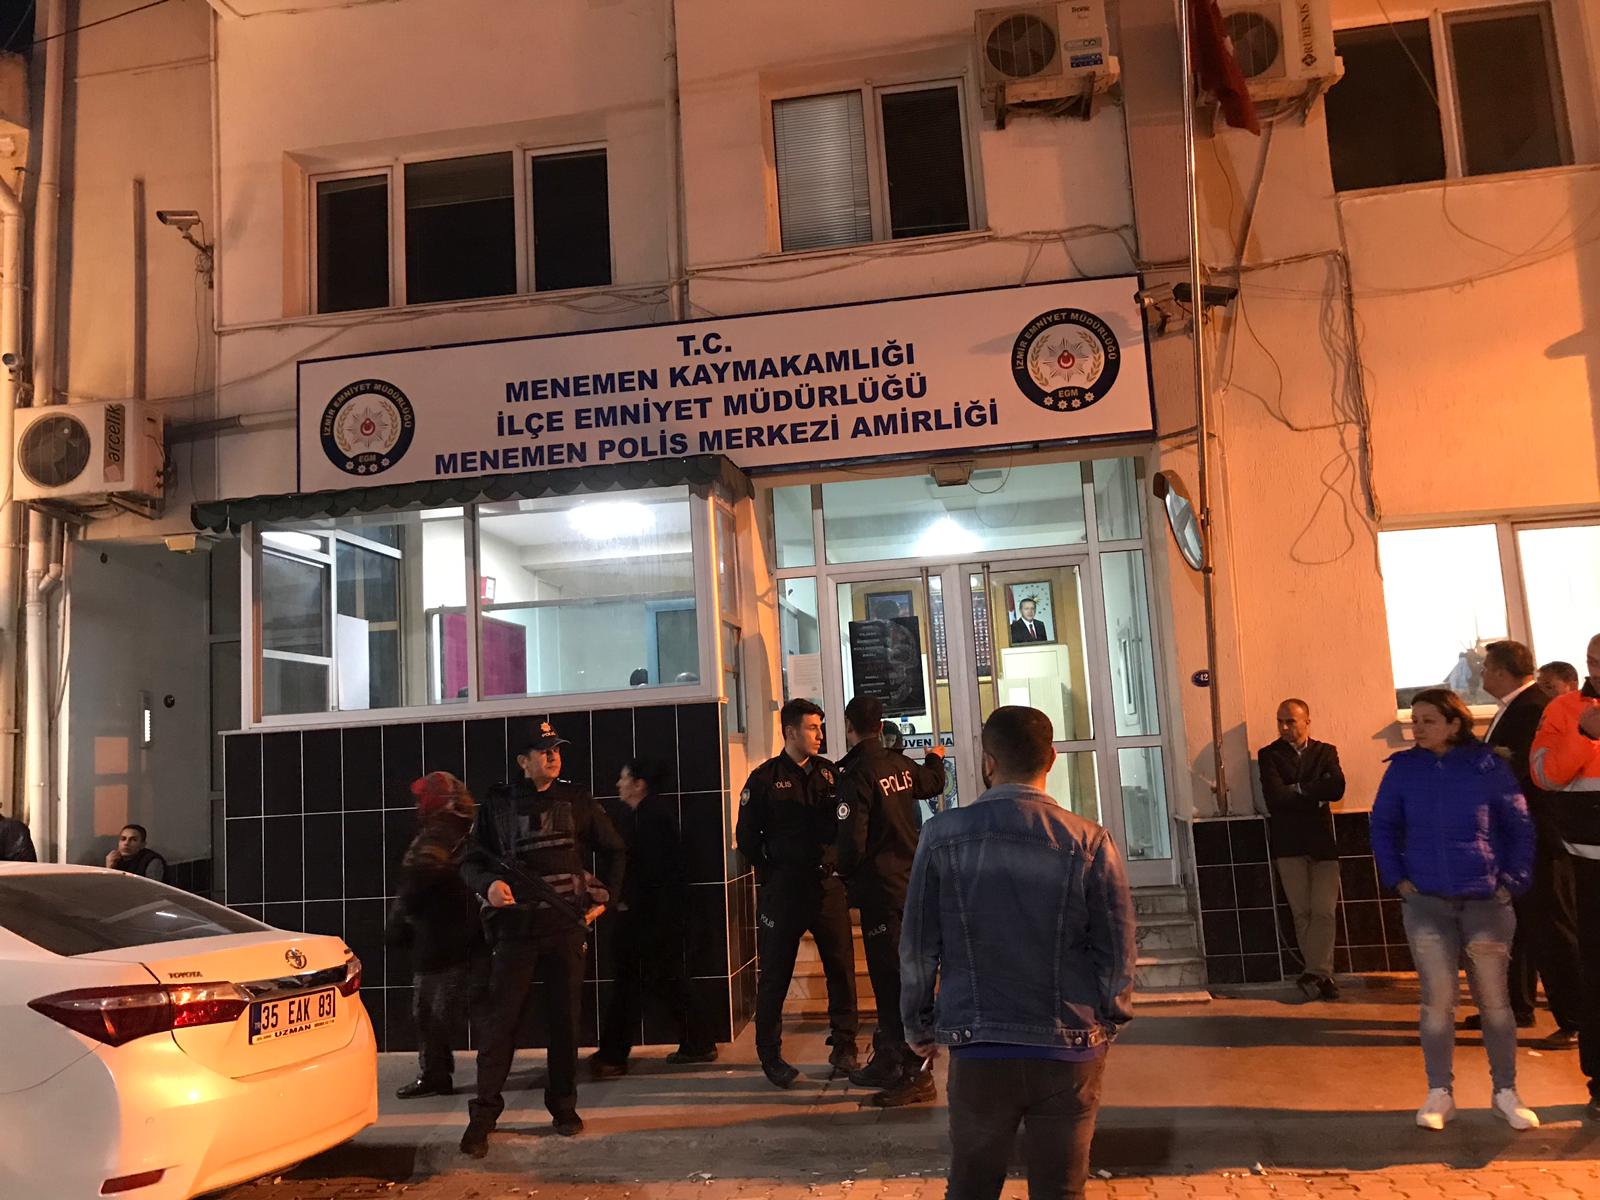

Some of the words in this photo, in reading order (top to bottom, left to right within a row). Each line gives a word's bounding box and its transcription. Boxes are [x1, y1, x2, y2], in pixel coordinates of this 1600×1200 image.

[1024, 312, 1068, 339] EMNİYET
[677, 333, 732, 356] T.C.
[506, 371, 659, 403] MENEMEN
[670, 340, 915, 388] KAYMAKAMLIĞI
[334, 383, 372, 408] EMNİYET
[497, 408, 565, 439] İLÇE
[573, 396, 714, 428] EMNİYET
[724, 373, 926, 416] MÜDÜRLÜĞÜ
[1058, 389, 1079, 398] EGM
[435, 440, 587, 475] MENEMEN
[599, 428, 688, 460] POLİS
[699, 415, 839, 452] MERKEZİ
[851, 399, 998, 438] AMİRLİĞİ
[262, 1004, 279, 1030] 35
[288, 998, 311, 1024] EAK
[318, 993, 332, 1018] 83
[274, 1023, 312, 1038] UZMAN
